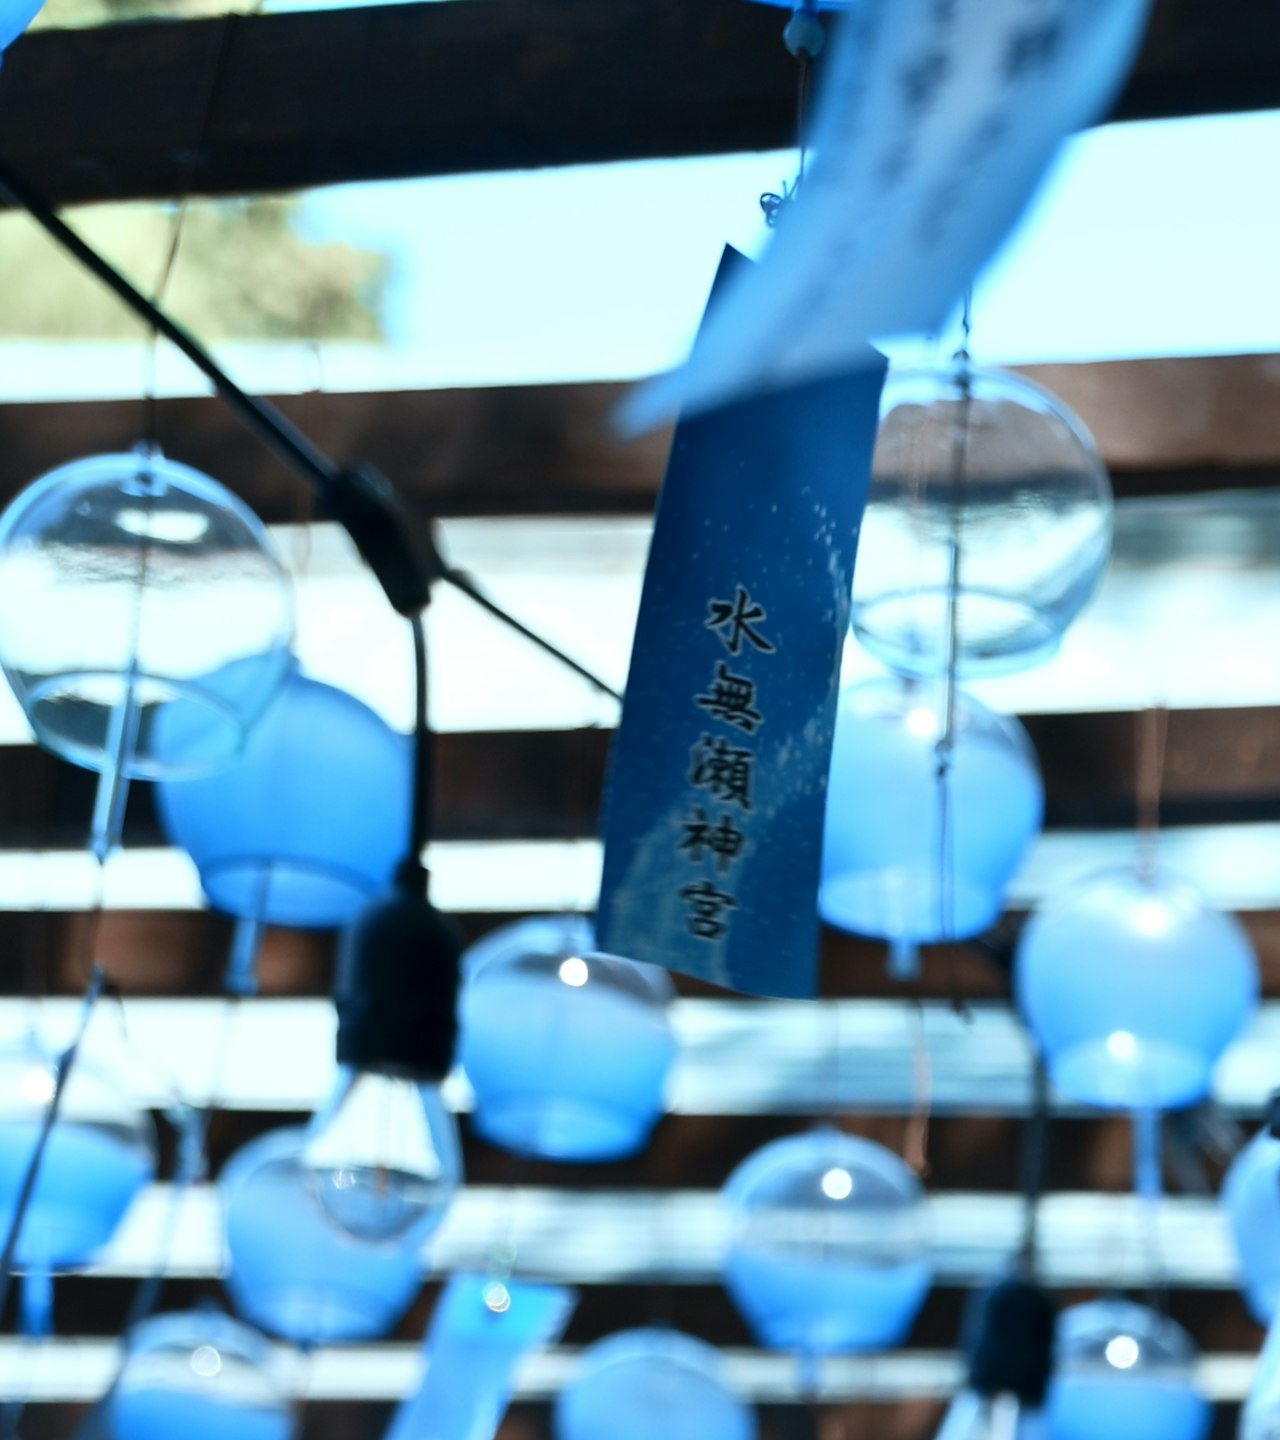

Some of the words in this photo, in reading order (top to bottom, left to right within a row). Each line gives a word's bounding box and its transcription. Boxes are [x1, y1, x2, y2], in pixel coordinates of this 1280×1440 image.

[677, 585, 776, 940] 水無瀬神宮
